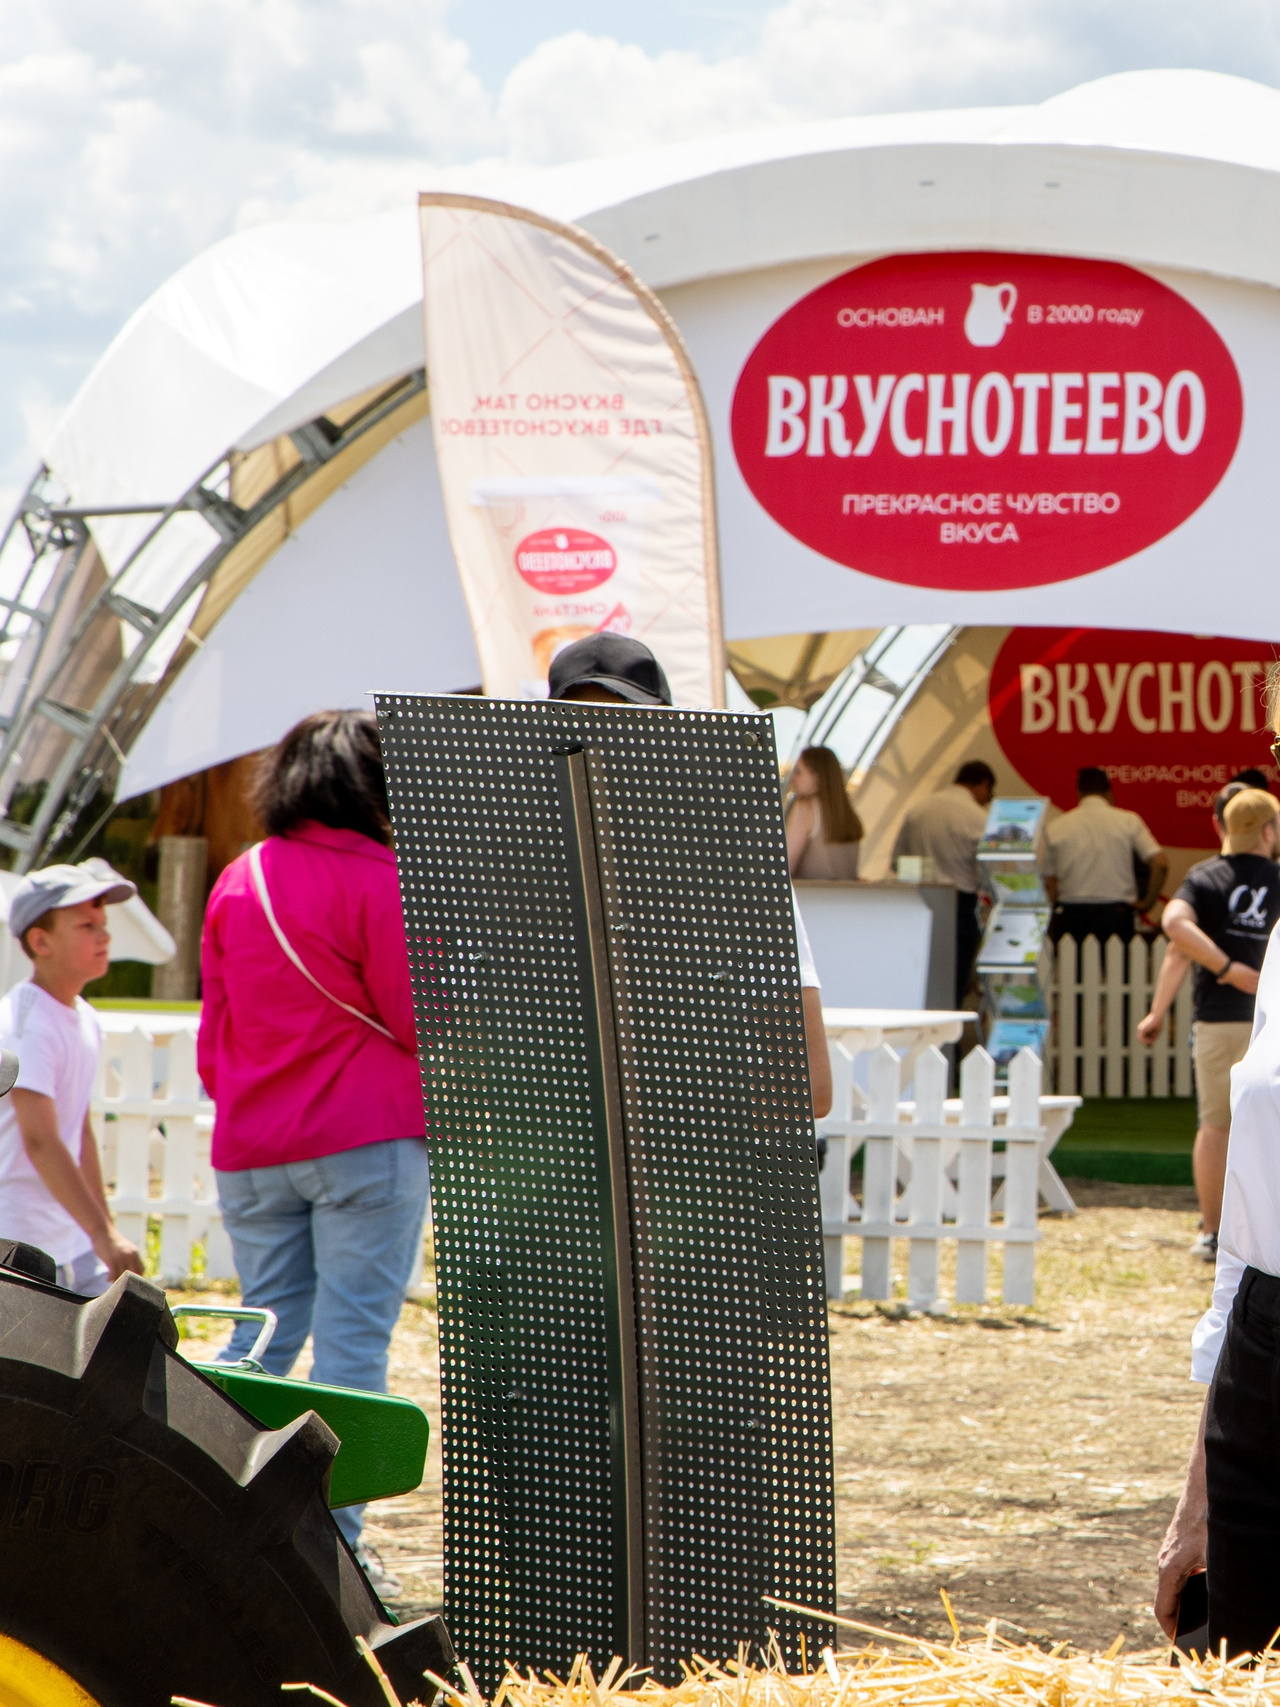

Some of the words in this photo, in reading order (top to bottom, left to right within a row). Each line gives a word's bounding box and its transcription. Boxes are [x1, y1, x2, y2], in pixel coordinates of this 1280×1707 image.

[837, 307, 945, 327] ОСНОВАН
[1027, 305, 1042, 324] В
[1046, 305, 1094, 324] 2000
[1097, 307, 1144, 328] году
[764, 370, 1206, 458] ВКУСНОТЕЕВО
[842, 494, 1002, 515] ПРЕКРАСНОЕ
[1006, 493, 1121, 514] ЧУВСТВО
[939, 523, 1019, 544] ВКУСА
